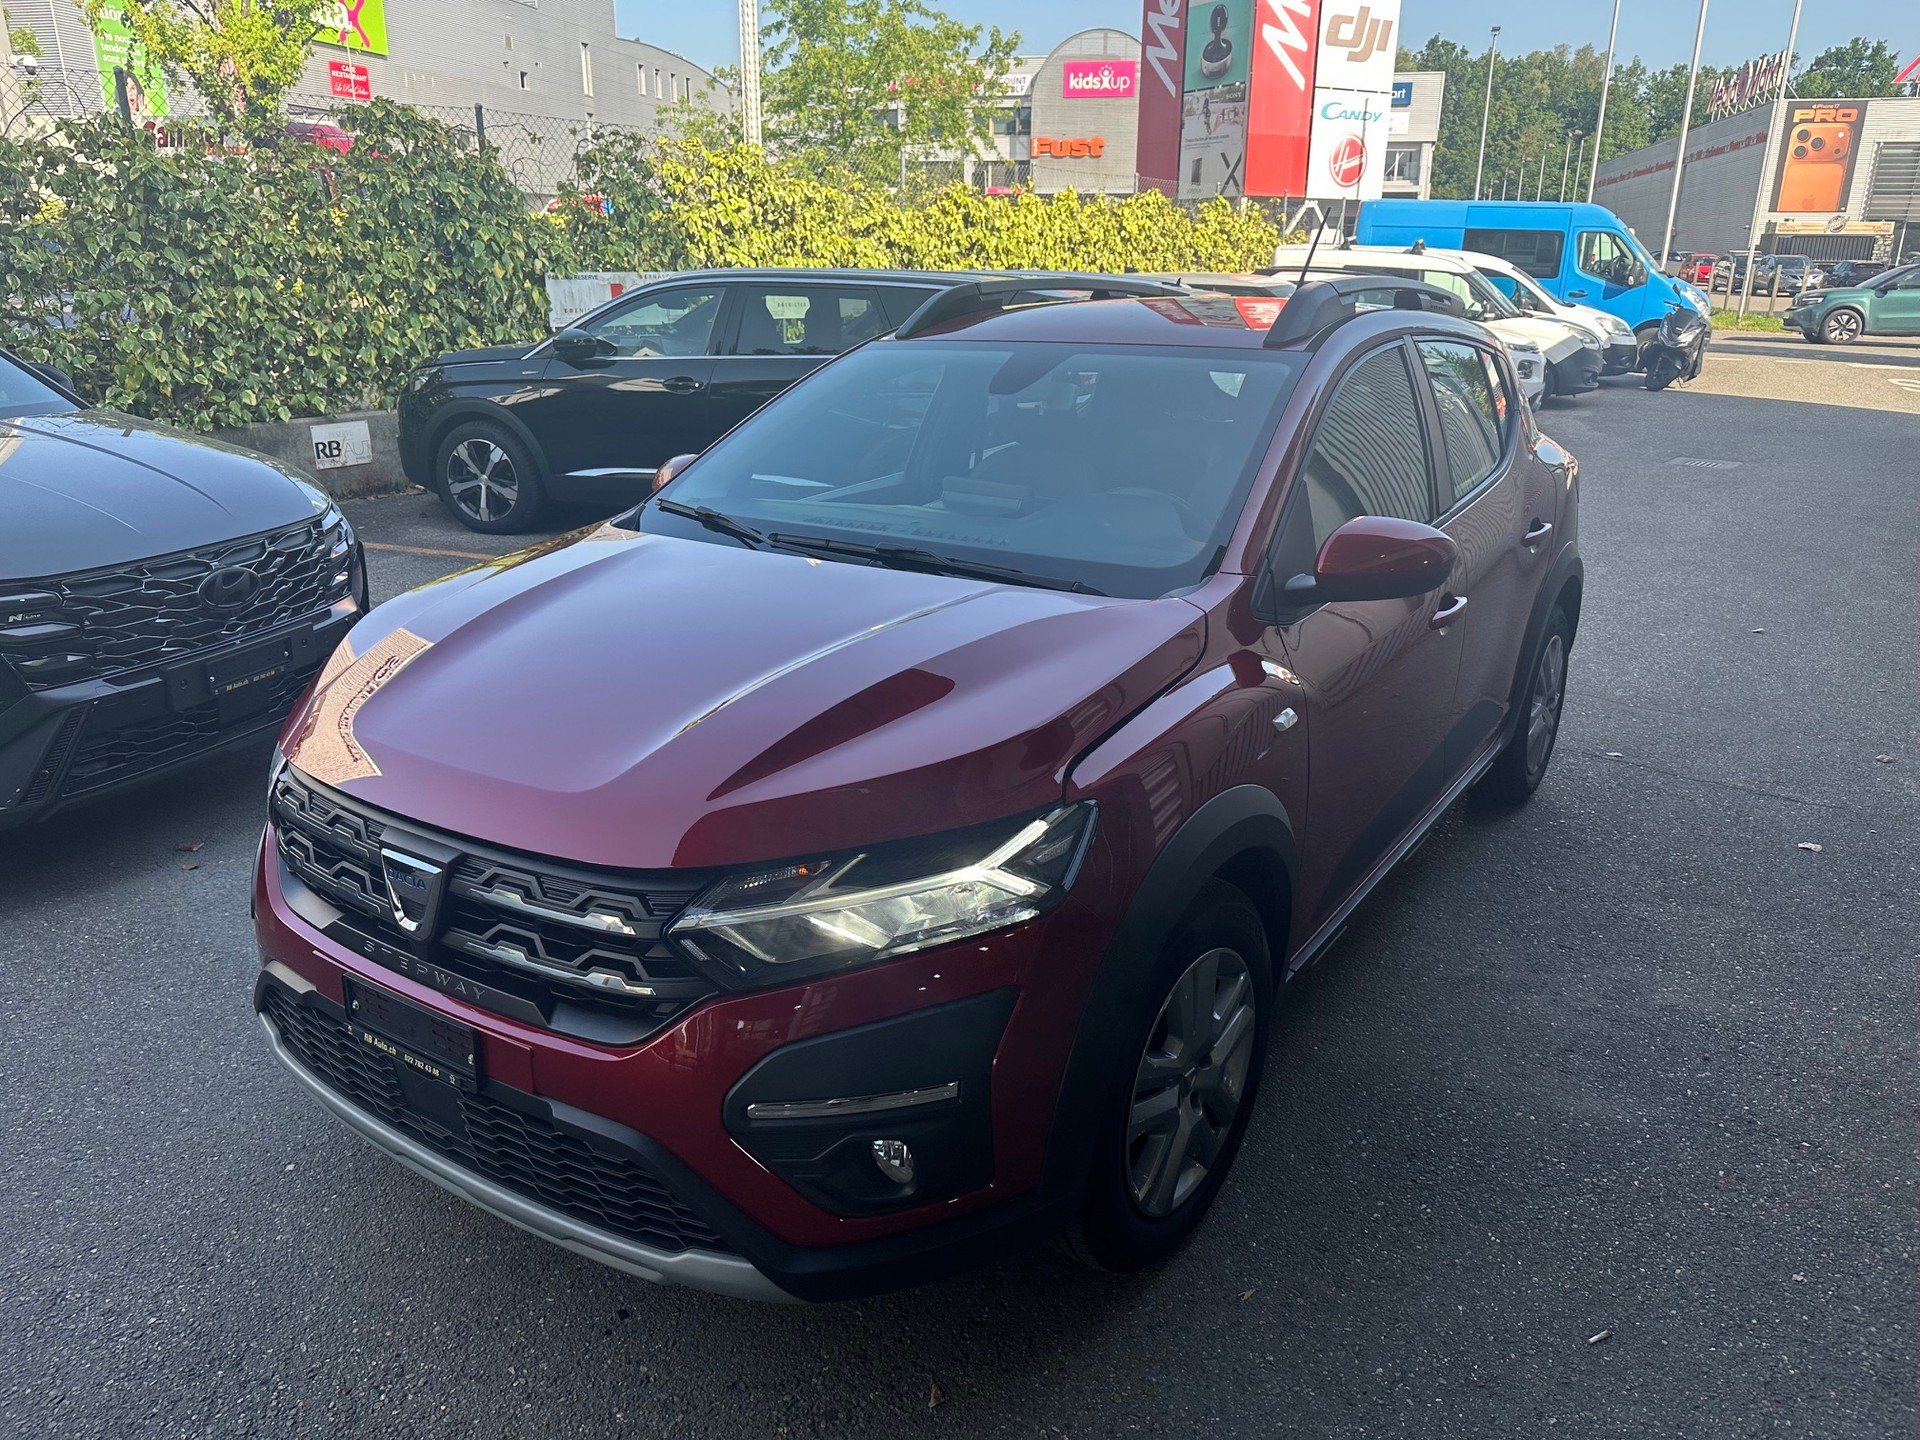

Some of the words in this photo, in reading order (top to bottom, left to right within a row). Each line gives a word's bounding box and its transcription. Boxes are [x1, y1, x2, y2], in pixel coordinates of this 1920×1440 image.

[1391, 88, 1406, 98] art
[1793, 108, 1858, 122] PRO
[1032, 135, 1105, 158] Fust
[387, 868, 427, 890] DACIA
[363, 940, 486, 1000] STEPWAY
[363, 1032, 373, 1044] RB
[373, 1038, 397, 1056] Auto.ch
[424, 1063, 432, 1072] 43
